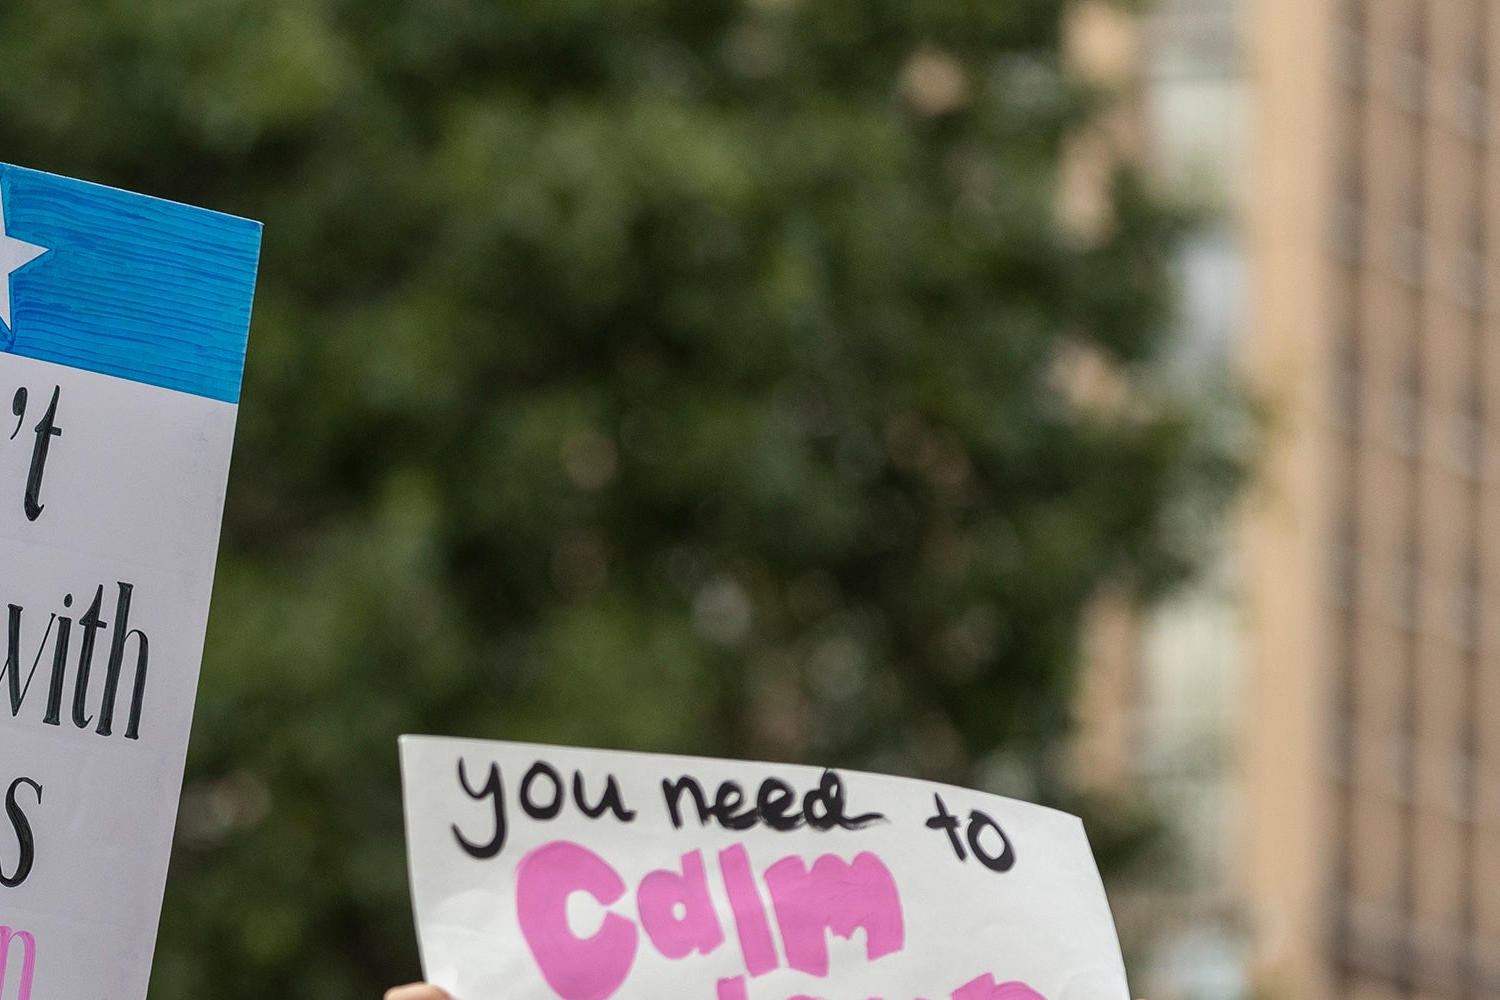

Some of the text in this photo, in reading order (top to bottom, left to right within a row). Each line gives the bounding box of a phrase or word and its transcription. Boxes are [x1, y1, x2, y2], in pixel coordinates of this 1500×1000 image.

[452, 757, 1016, 873] you need to
